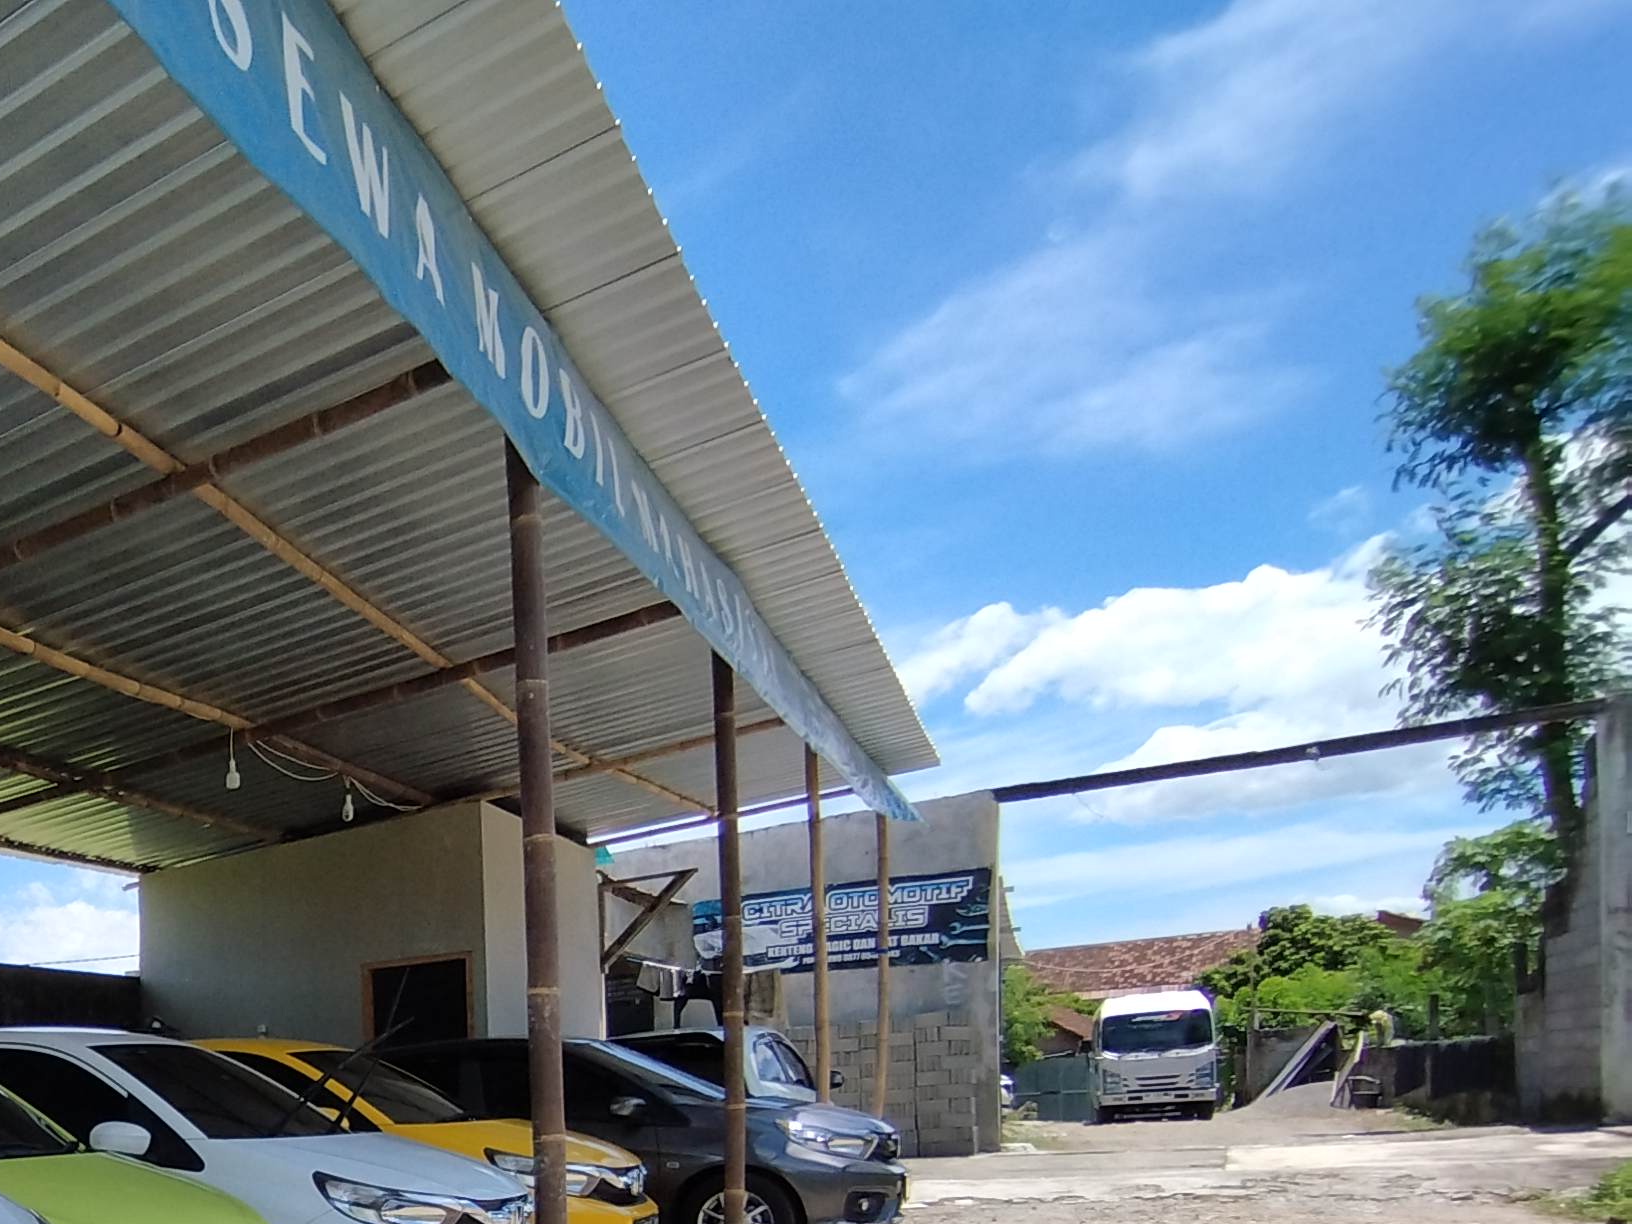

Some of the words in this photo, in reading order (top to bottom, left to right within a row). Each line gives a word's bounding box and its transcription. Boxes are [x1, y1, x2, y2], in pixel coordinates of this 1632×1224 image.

[470, 260, 626, 519] MOBIL
[827, 877, 972, 912] OTOMOTIF
[779, 905, 928, 939] SPCIAIS
